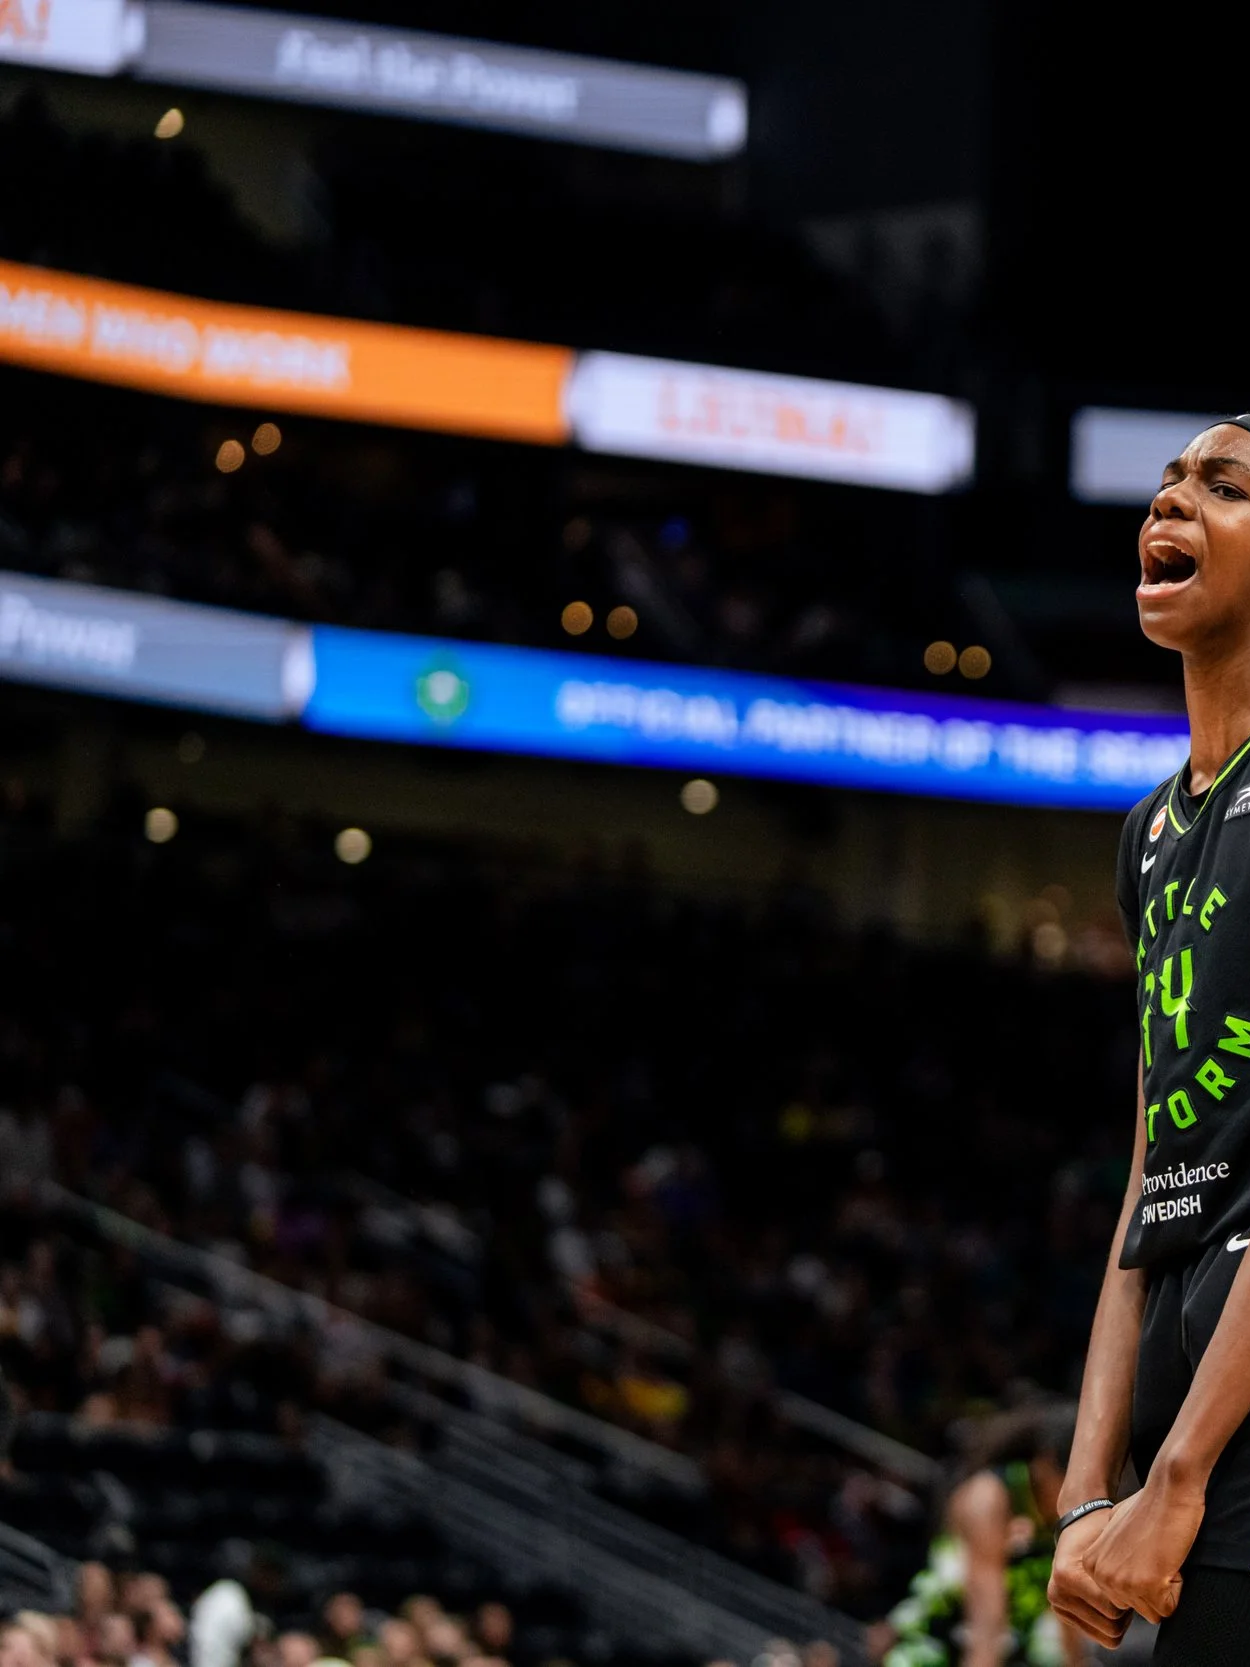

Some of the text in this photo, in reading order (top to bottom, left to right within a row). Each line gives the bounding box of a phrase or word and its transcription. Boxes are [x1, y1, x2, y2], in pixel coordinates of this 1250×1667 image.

[1142, 1162, 1230, 1196] Providence
[1142, 1194, 1202, 1225] SWEDISH
[1072, 1505, 1085, 1516] God
